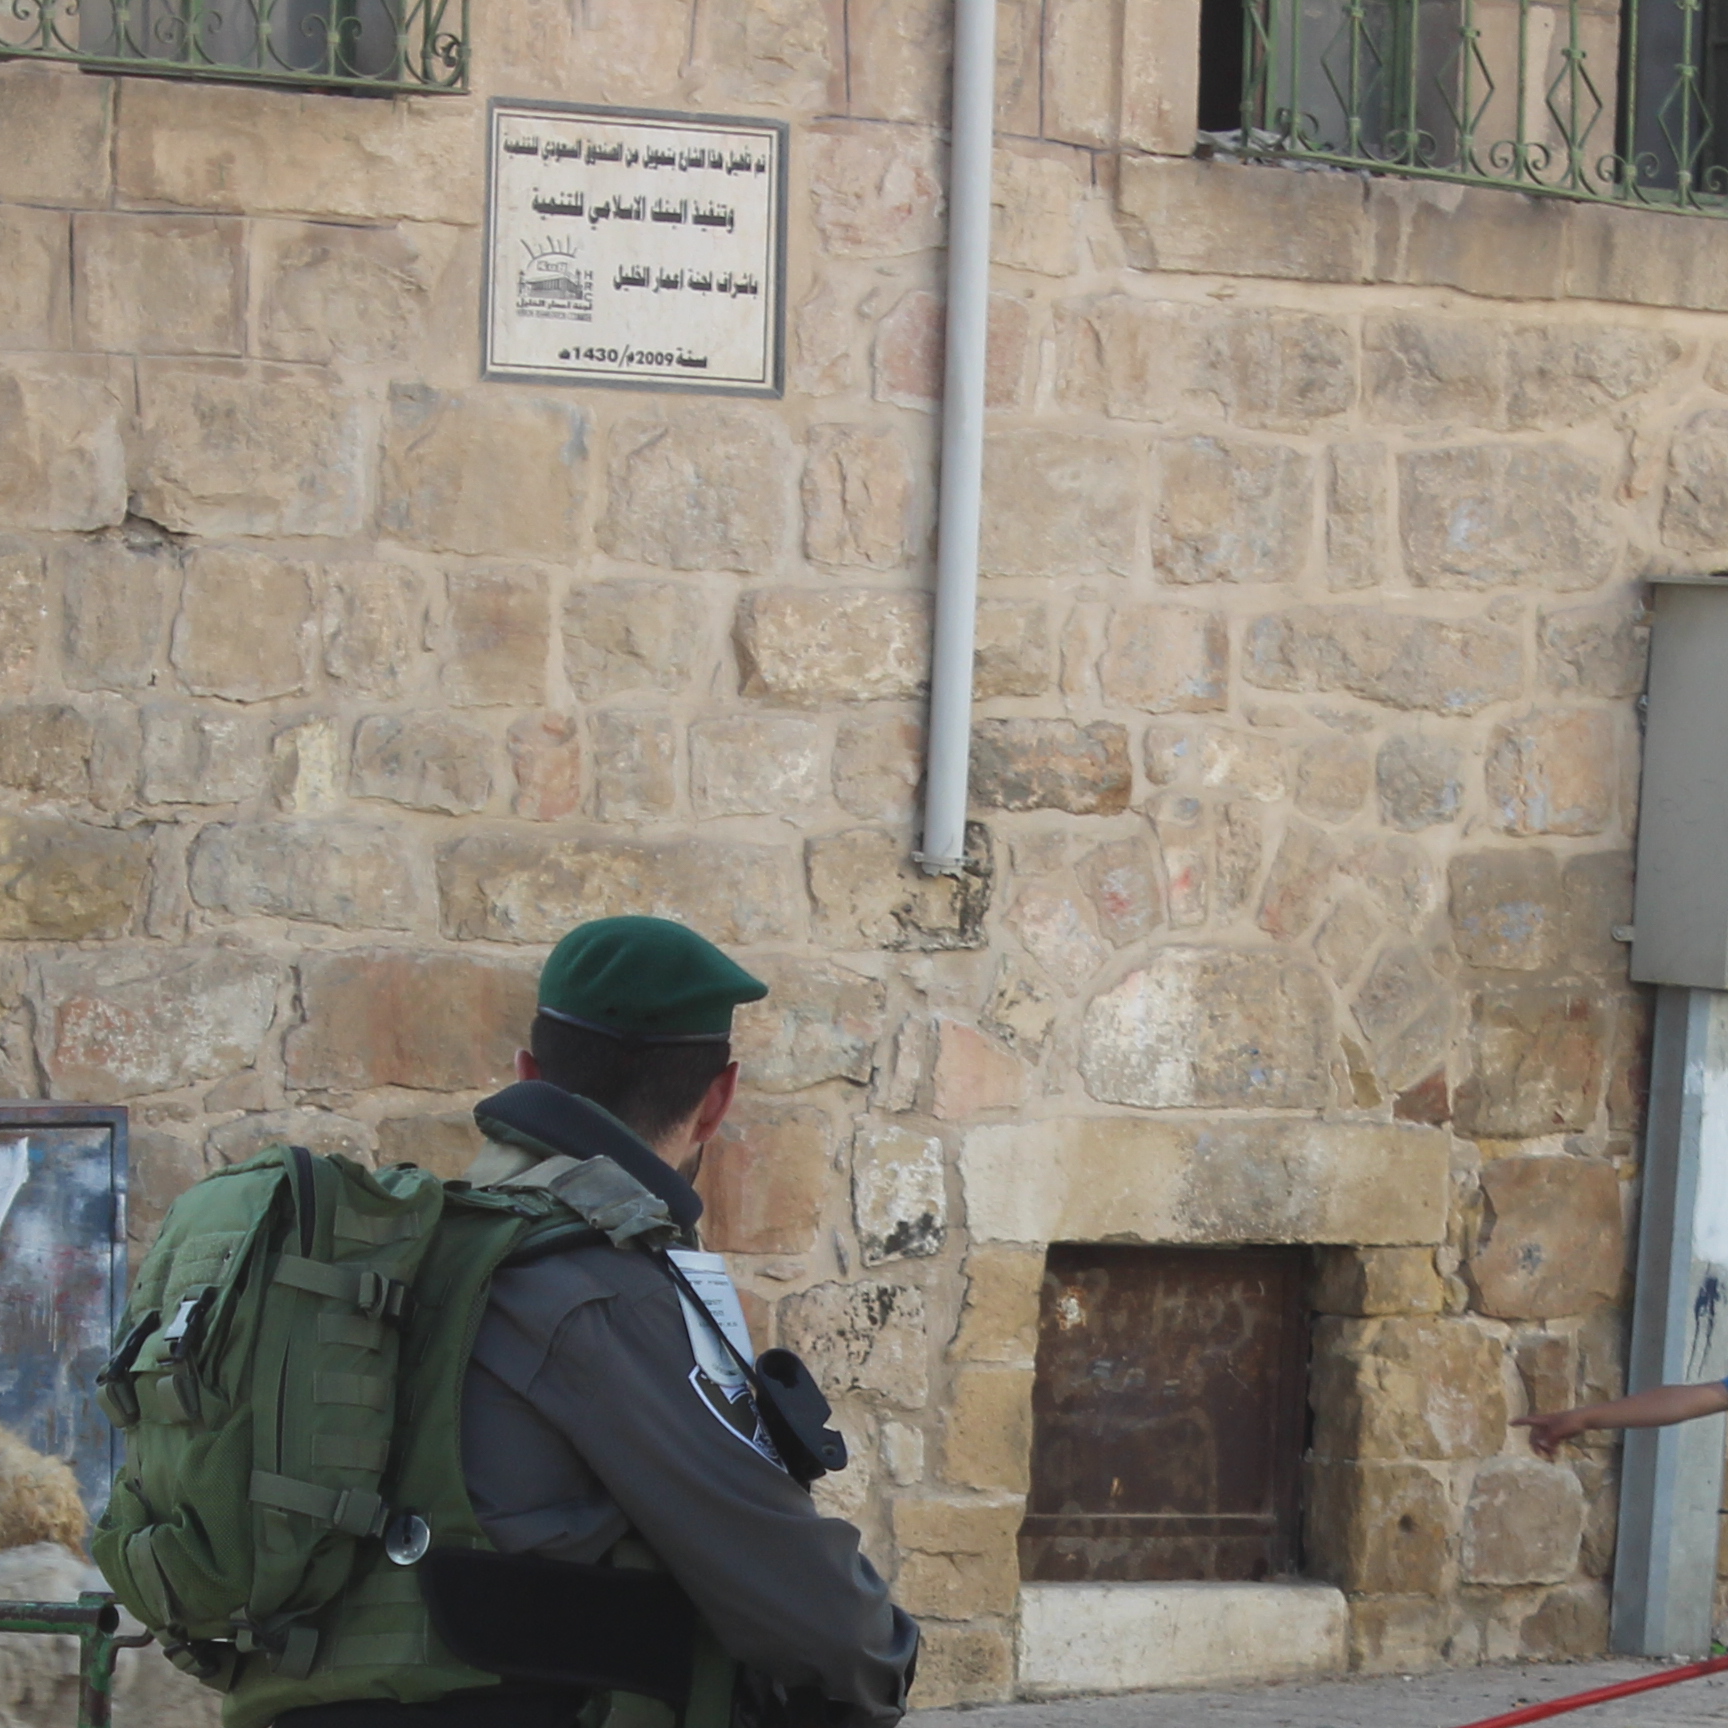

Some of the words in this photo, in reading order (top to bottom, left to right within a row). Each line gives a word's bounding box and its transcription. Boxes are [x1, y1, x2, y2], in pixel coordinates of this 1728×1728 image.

[503, 132, 539, 160] للتنمية
[542, 138, 582, 167] السعودي
[584, 138, 623, 166] الصندوق
[625, 147, 639, 168] من
[643, 144, 675, 170] بتمويل
[678, 147, 705, 172] الشارع
[707, 148, 722, 170] هذا
[754, 154, 765, 178] تم
[531, 186, 584, 221] للتنمية
[651, 197, 687, 229] البنك
[692, 199, 735, 234] وتنفيذ
[613, 263, 650, 292] الخليل
[687, 267, 712, 297] لجنة
[675, 346, 708, 369] سنة
